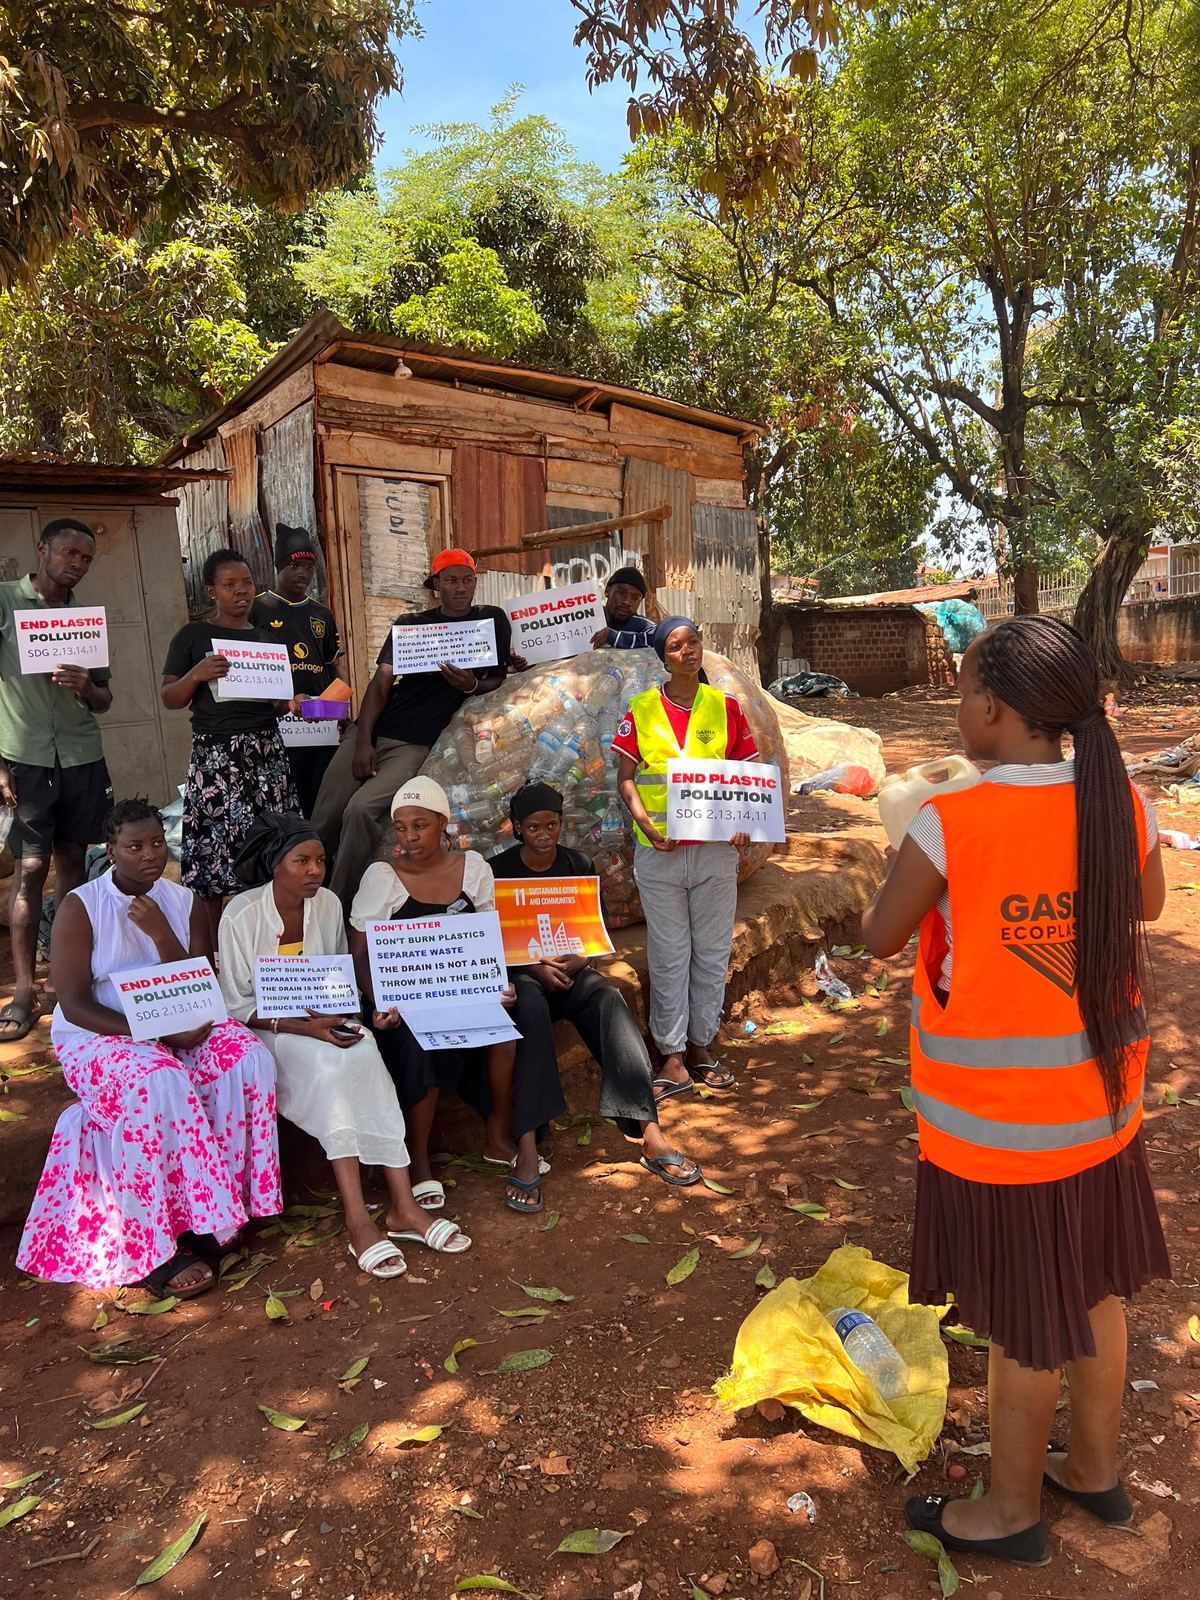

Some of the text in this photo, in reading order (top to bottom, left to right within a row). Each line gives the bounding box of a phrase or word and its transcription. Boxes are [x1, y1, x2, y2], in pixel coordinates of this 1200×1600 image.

[510, 593, 597, 621] END PLASTIC
[20, 618, 104, 630] END PLASTIC
[520, 608, 595, 632] POLLUTION
[29, 630, 100, 642] POLLUTION
[521, 637, 543, 649] SDG
[28, 649, 50, 657] SDG
[217, 649, 287, 660] END PLASTIC
[672, 773, 776, 788] END PLASTIC
[681, 789, 772, 804] POLLUTION
[676, 809, 702, 819] SDG
[513, 888, 526, 906] 11
[529, 887, 562, 895] SUSTAINABLE
[542, 896, 575, 905] COMMUNITIES
[407, 921, 441, 930] LITTER
[376, 930, 485, 945] DON'T BURN PLASTICS
[377, 946, 464, 959] SEPARATE WASTE
[402, 963, 432, 972] DRAIN
[448, 960, 467, 968] NOT
[480, 957, 497, 965] BIN
[120, 968, 212, 992] END PLASTIC
[380, 979, 416, 987] THROW
[133, 981, 213, 1004] POLLUTION
[382, 984, 504, 1002] REDUCE REUSE RECYCLE
[136, 1009, 160, 1021] SDG
